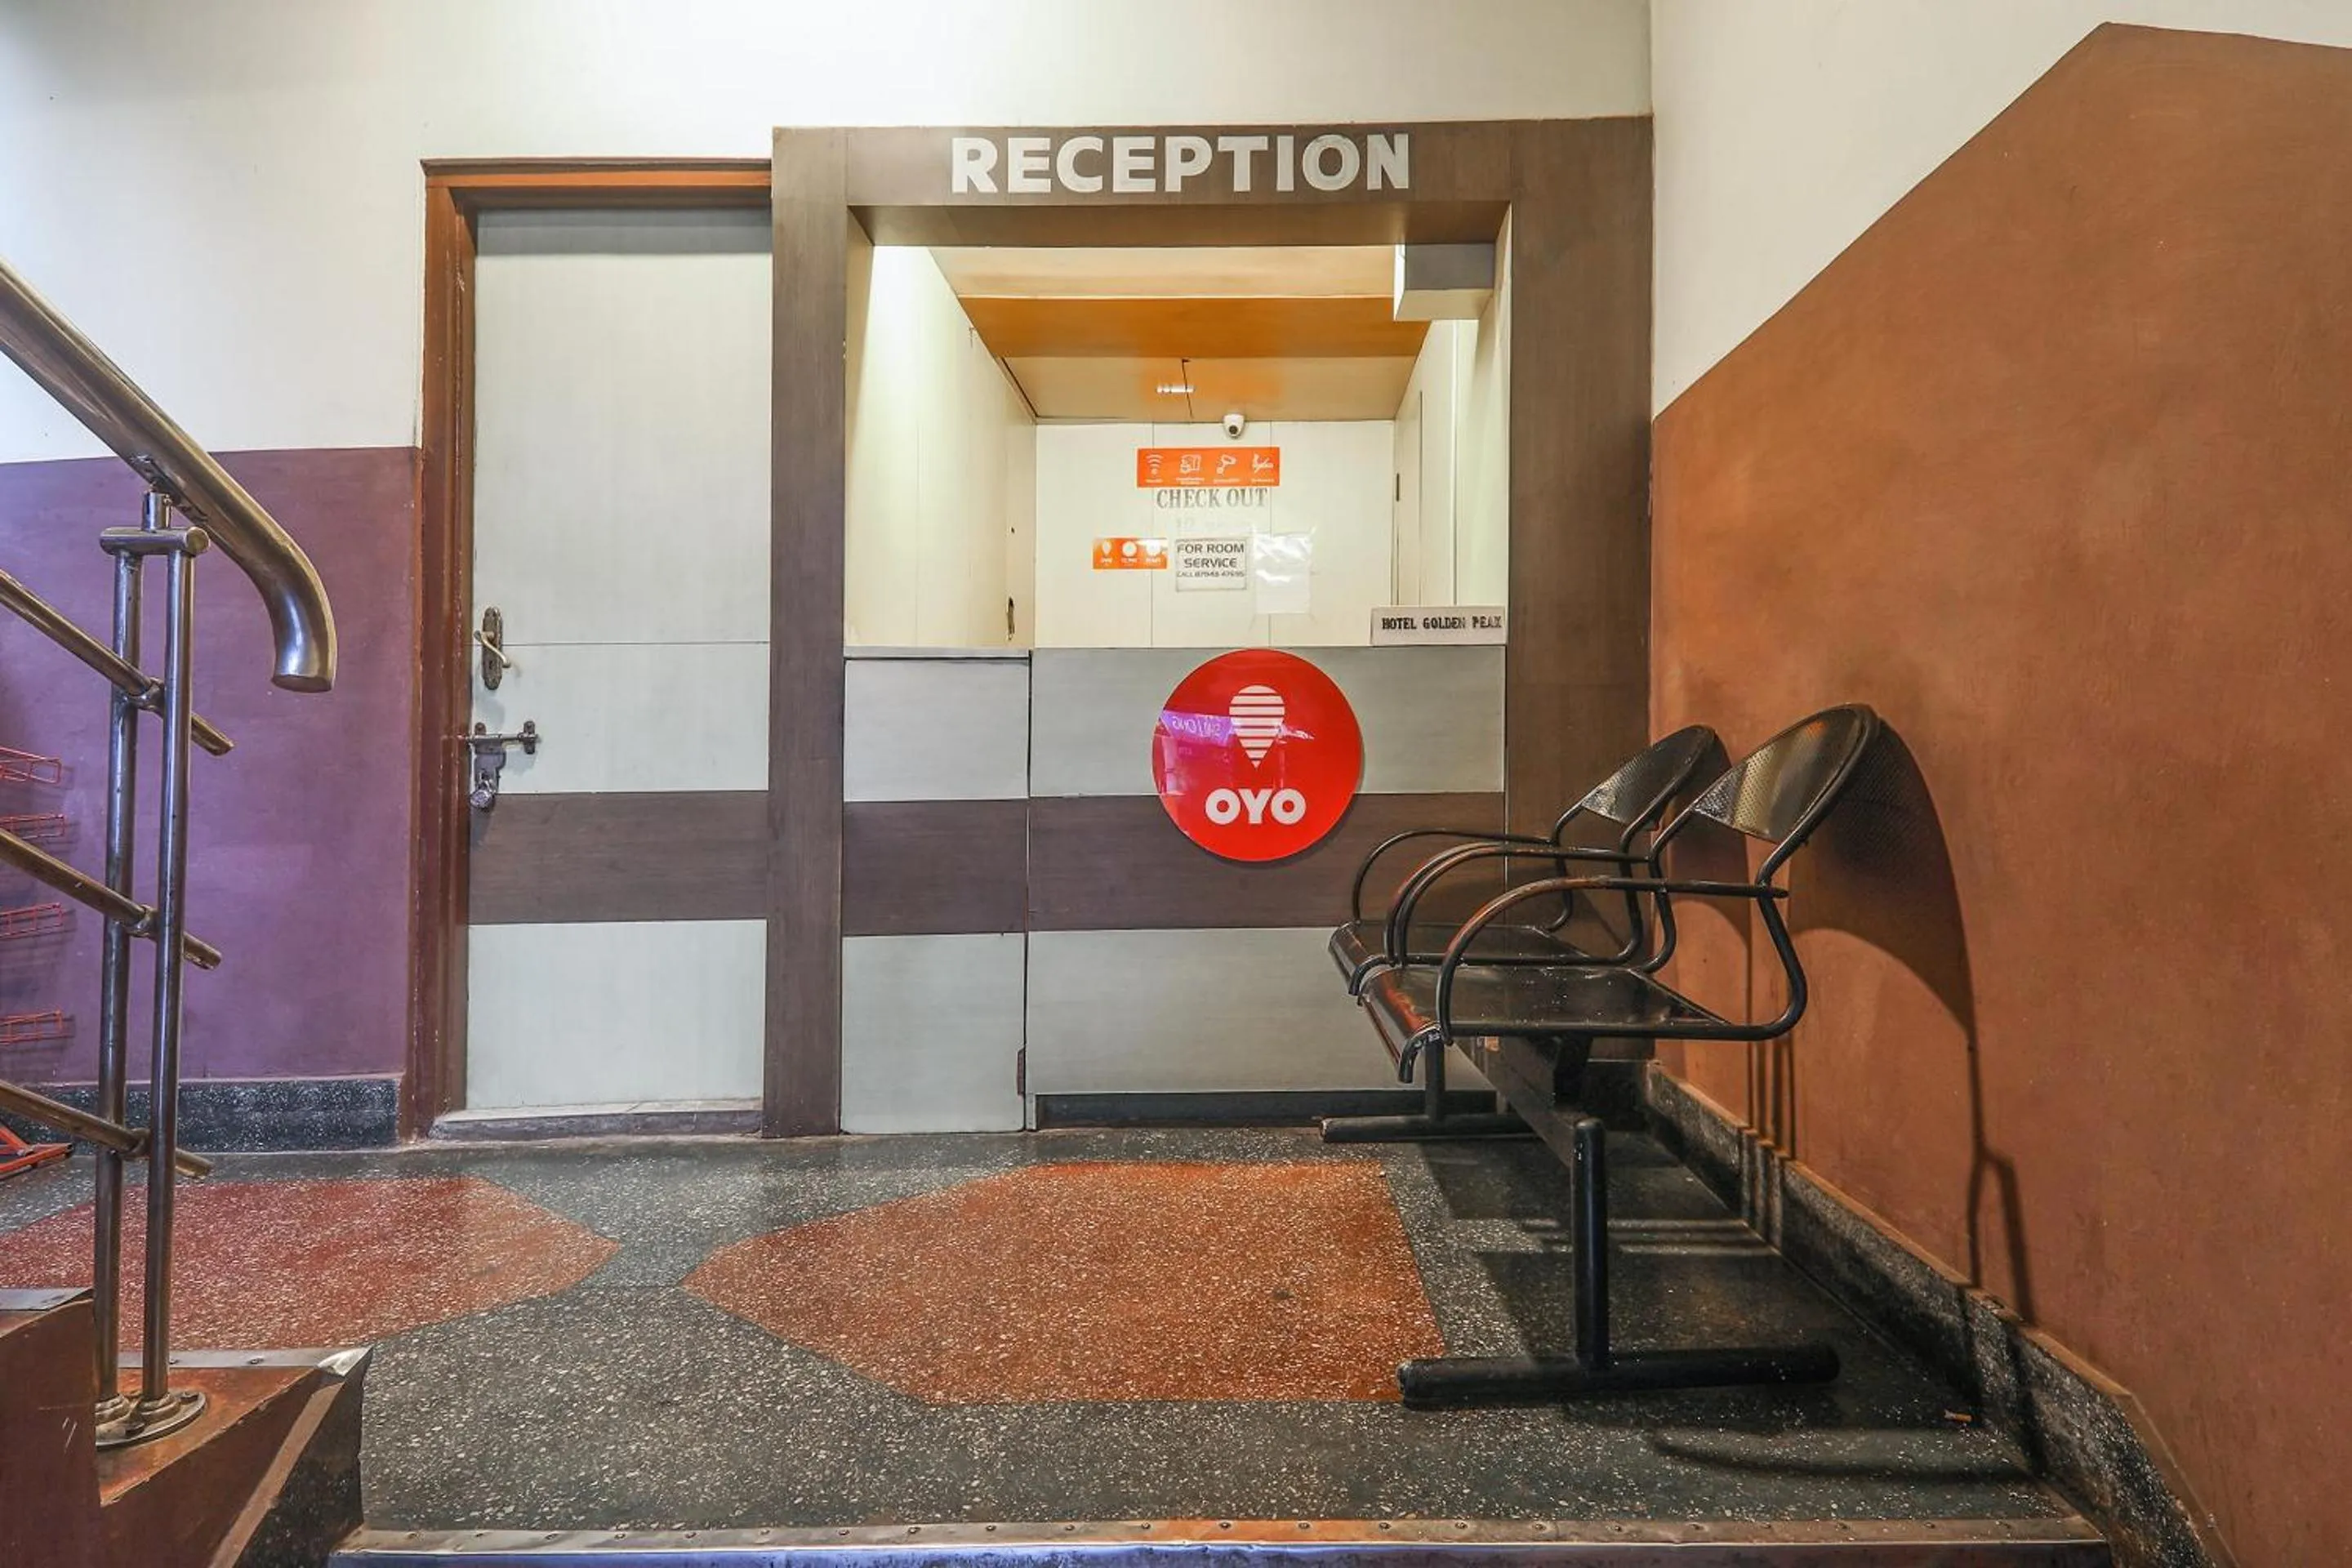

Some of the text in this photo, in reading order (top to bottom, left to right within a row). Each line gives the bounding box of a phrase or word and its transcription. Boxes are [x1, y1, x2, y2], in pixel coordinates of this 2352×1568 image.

[951, 134, 1410, 194] RECEPTION
[1156, 488, 1267, 509] CHECK OUT
[1177, 543, 1245, 554] FOR ROOM
[1183, 557, 1237, 568] SERVICE
[1382, 617, 1417, 630] HOTEL
[1423, 617, 1466, 630] GOLDEN
[1205, 787, 1307, 826] OYO
